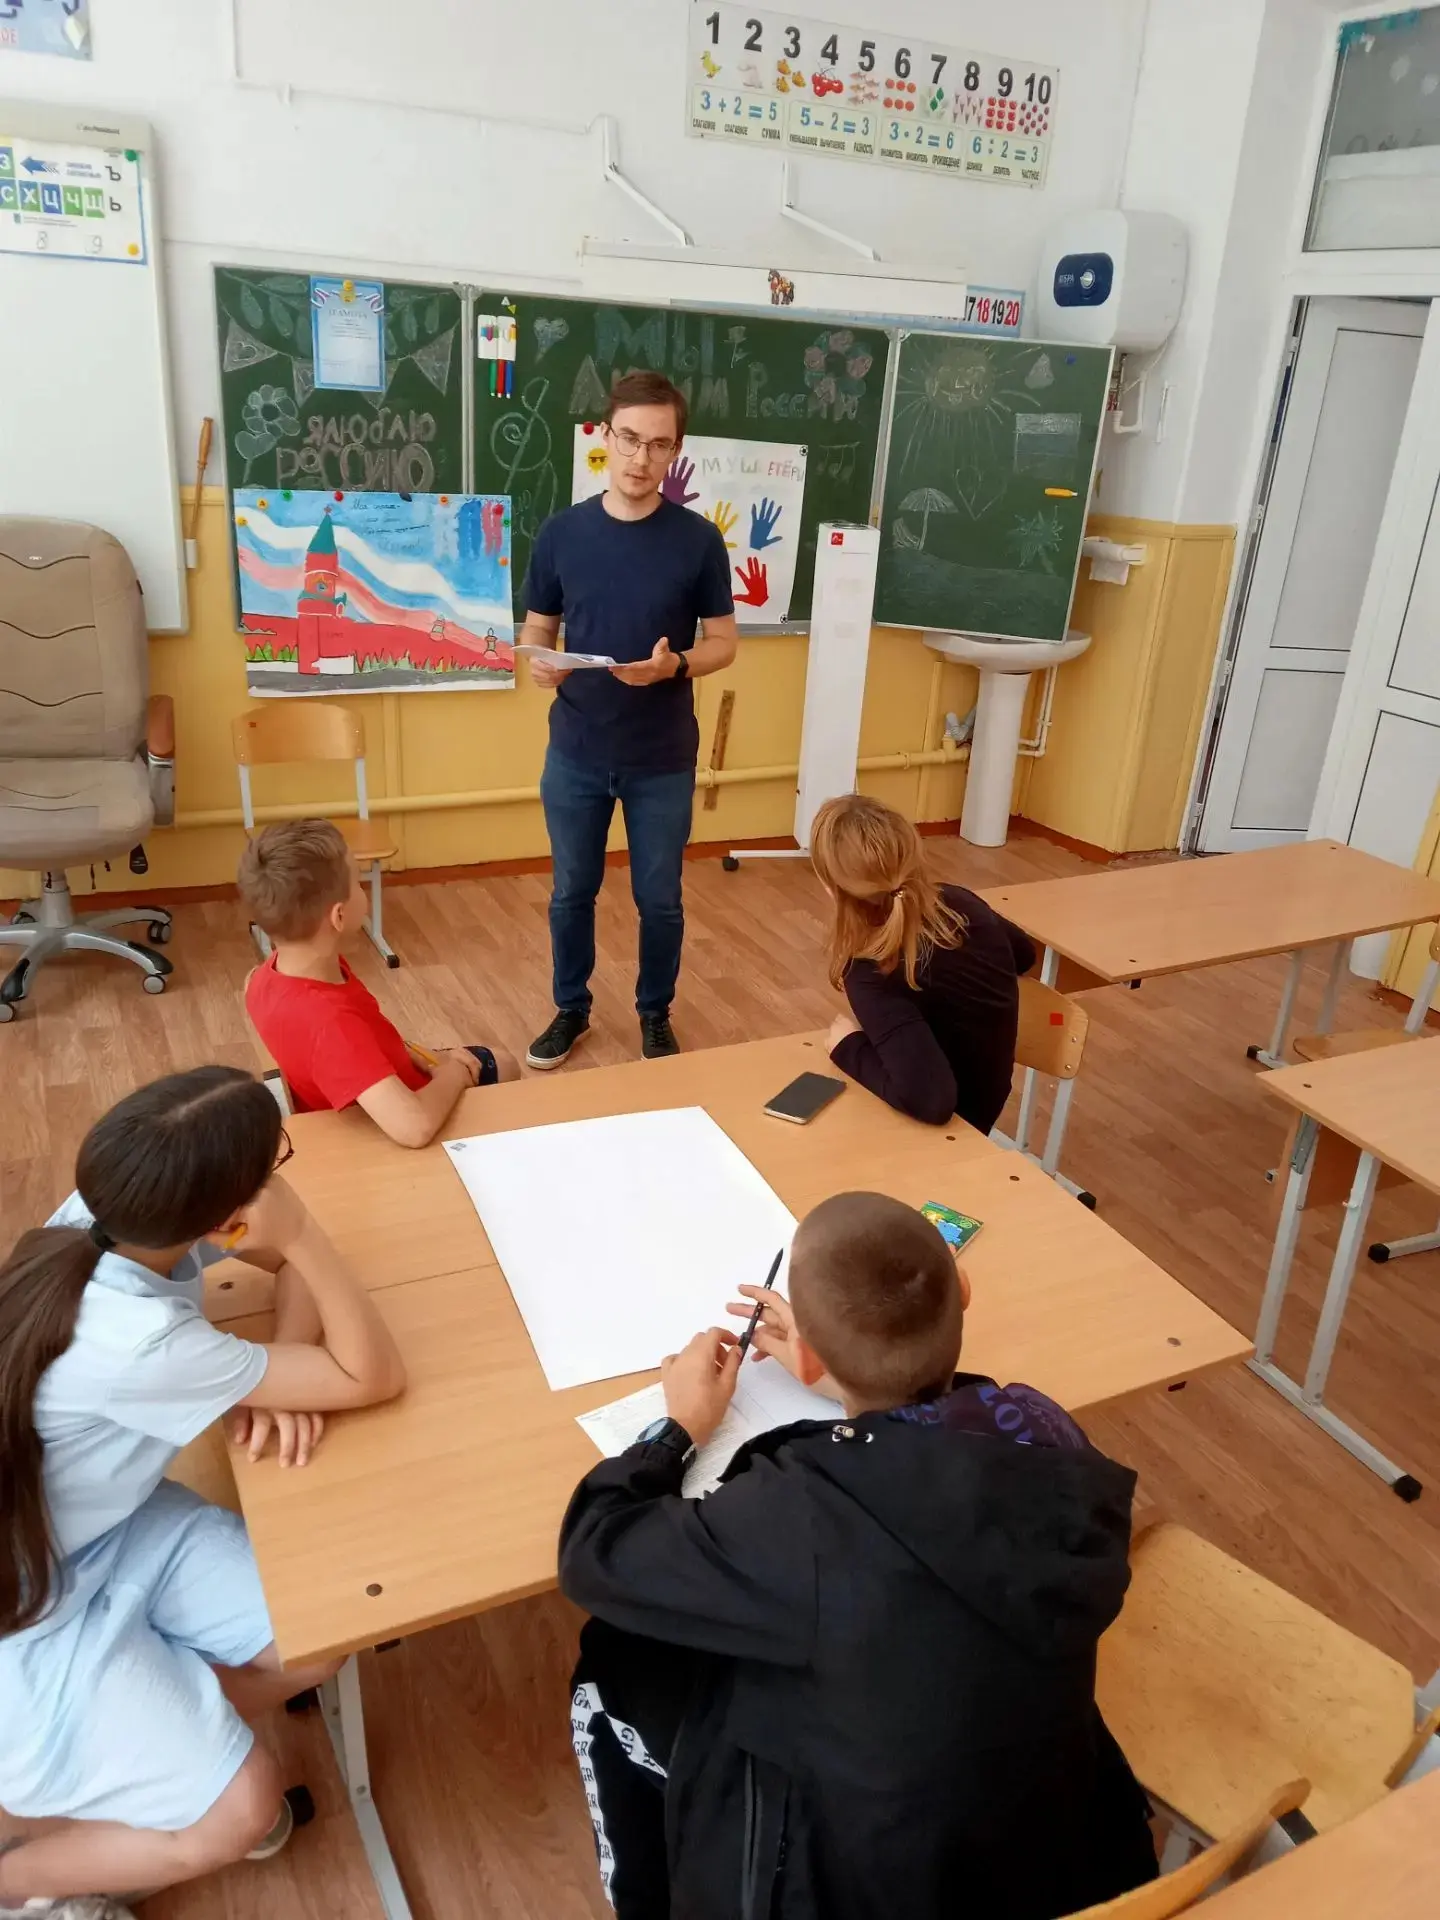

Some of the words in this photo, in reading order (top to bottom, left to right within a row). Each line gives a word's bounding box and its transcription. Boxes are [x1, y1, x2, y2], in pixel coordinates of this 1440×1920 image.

[706, 11, 720, 45] 1
[744, 18, 763, 53] 2
[783, 26, 801, 59] 3
[820, 34, 839, 66] 4
[858, 40, 876, 72] 5
[894, 47, 912, 79] 6
[931, 53, 947, 85] 7
[963, 61, 980, 92] 8
[997, 67, 1013, 97] 9
[1024, 72, 1052, 105] 10
[700, 90, 711, 111] 3
[718, 98, 727, 113] +
[733, 96, 742, 116] 2
[748, 104, 763, 119] =
[768, 101, 777, 121] 5
[761, 127, 781, 141] СУММА
[800, 106, 811, 126] 5
[830, 111, 839, 131] 2
[843, 120, 857, 134] =
[861, 116, 870, 136] 3
[889, 121, 900, 141] 3
[915, 125, 924, 145] 2
[927, 134, 940, 148] =
[946, 131, 955, 150] 6
[853, 141, 874, 155] РАЗНОСТЬ
[972, 135, 983, 154] 6
[1001, 140, 1009, 159] 2
[1013, 147, 1027, 162] =
[1030, 145, 1039, 164] 3
[44, 190, 59, 210] Ц
[977, 296, 990, 323] 18
[991, 298, 1005, 325] 19
[1004, 300, 1020, 327] 20
